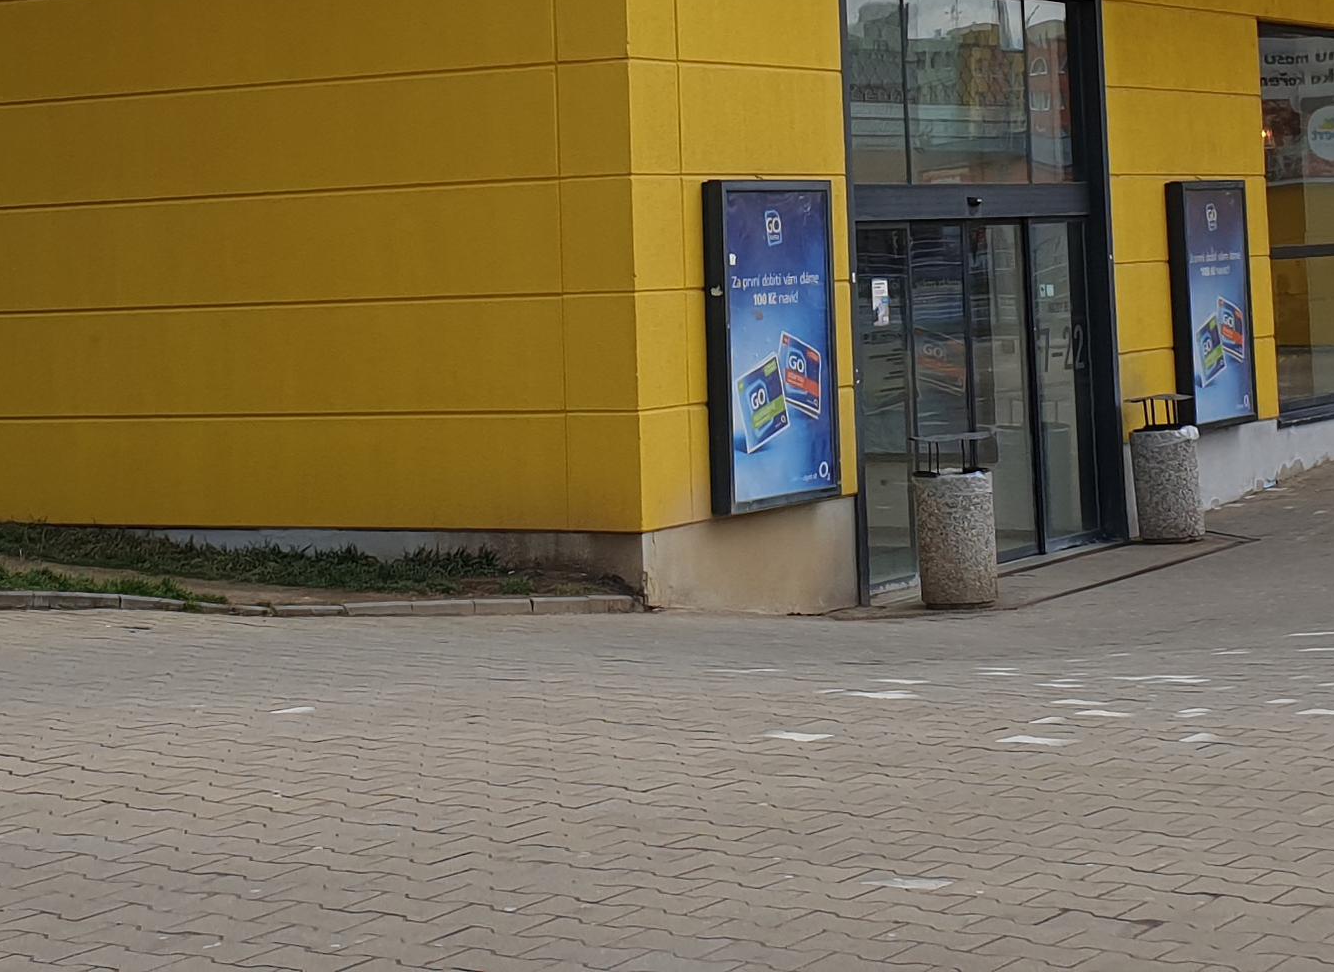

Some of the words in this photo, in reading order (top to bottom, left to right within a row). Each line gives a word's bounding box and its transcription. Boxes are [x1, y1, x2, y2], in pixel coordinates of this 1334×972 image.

[766, 216, 781, 233] GO
[753, 292, 767, 306] 100
[788, 355, 805, 373] GO
[750, 388, 766, 409] GO
